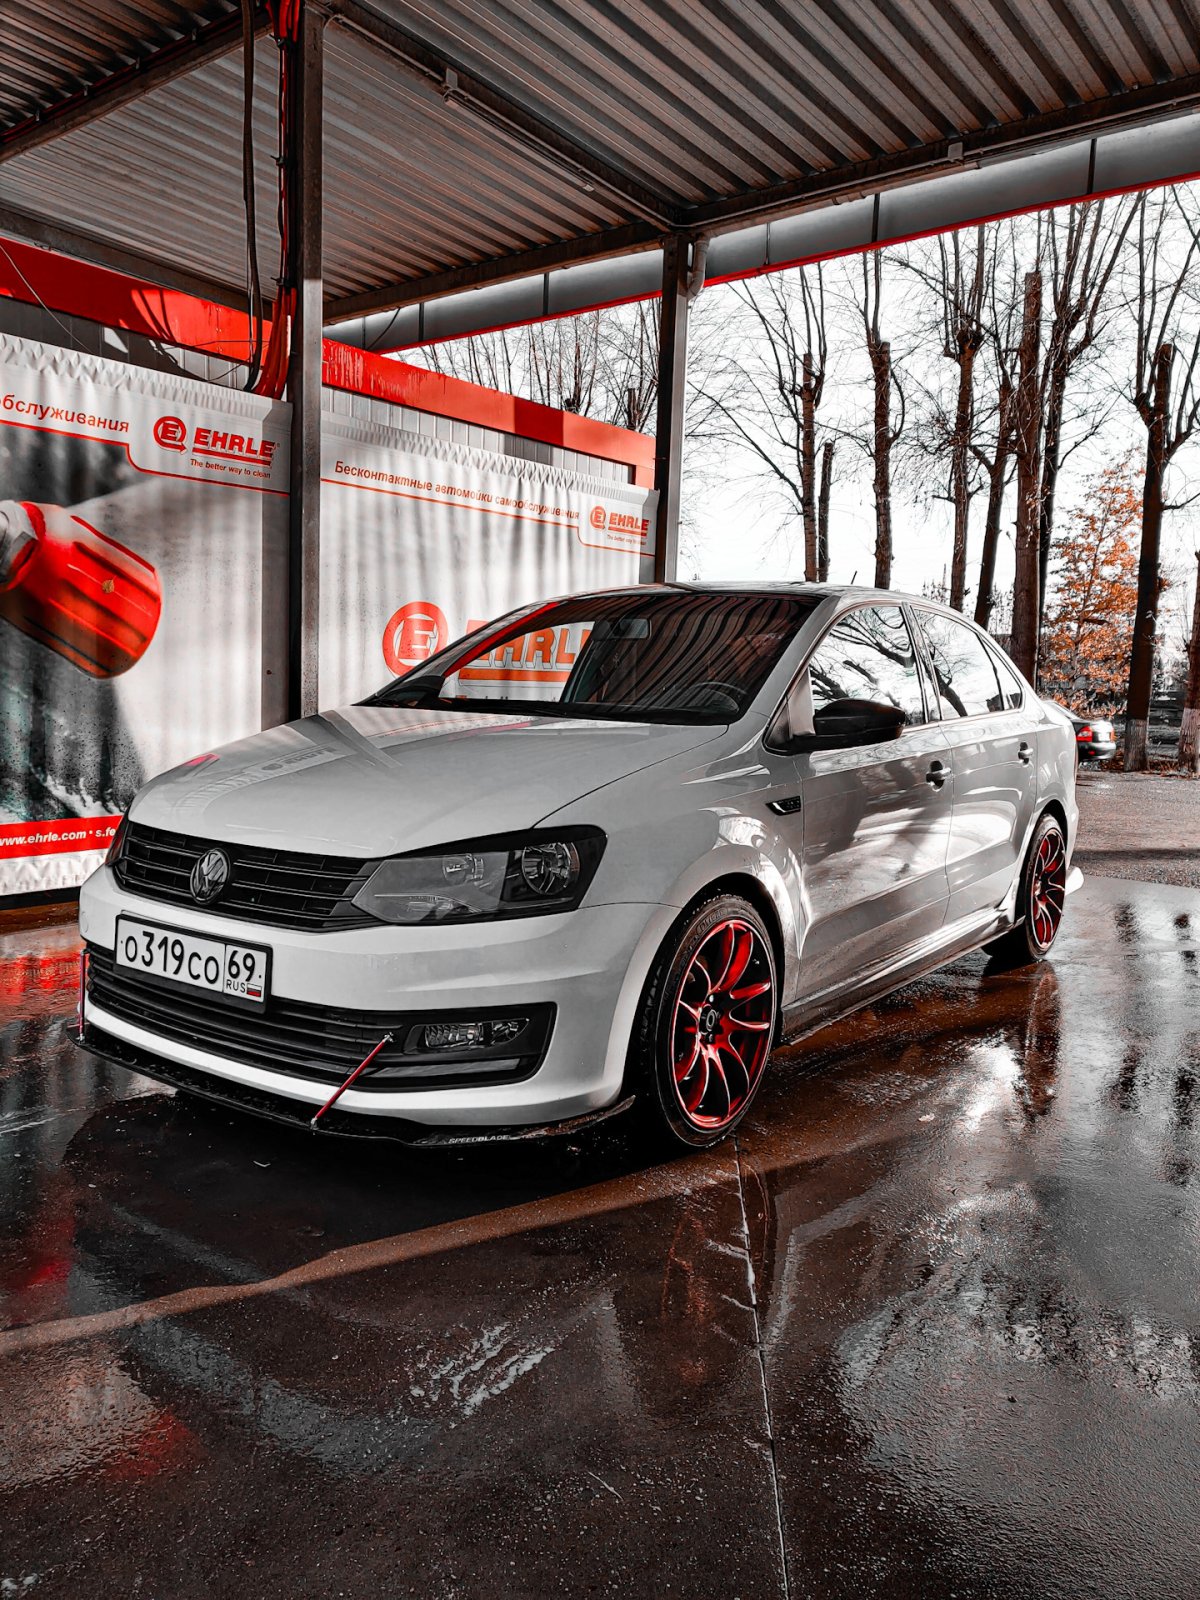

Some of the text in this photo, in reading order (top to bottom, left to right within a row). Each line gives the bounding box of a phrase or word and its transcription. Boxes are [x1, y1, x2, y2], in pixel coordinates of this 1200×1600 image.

[0, 394, 130, 433] бслуживания
[193, 427, 276, 458] EHRLE
[190, 458, 271, 479] The better way to clean
[335, 460, 433, 491] Бесконтактные
[435, 483, 493, 503] автомойки
[609, 512, 650, 531] EHRLE
[228, 950, 256, 982] 69
[225, 978, 247, 993] RUS
